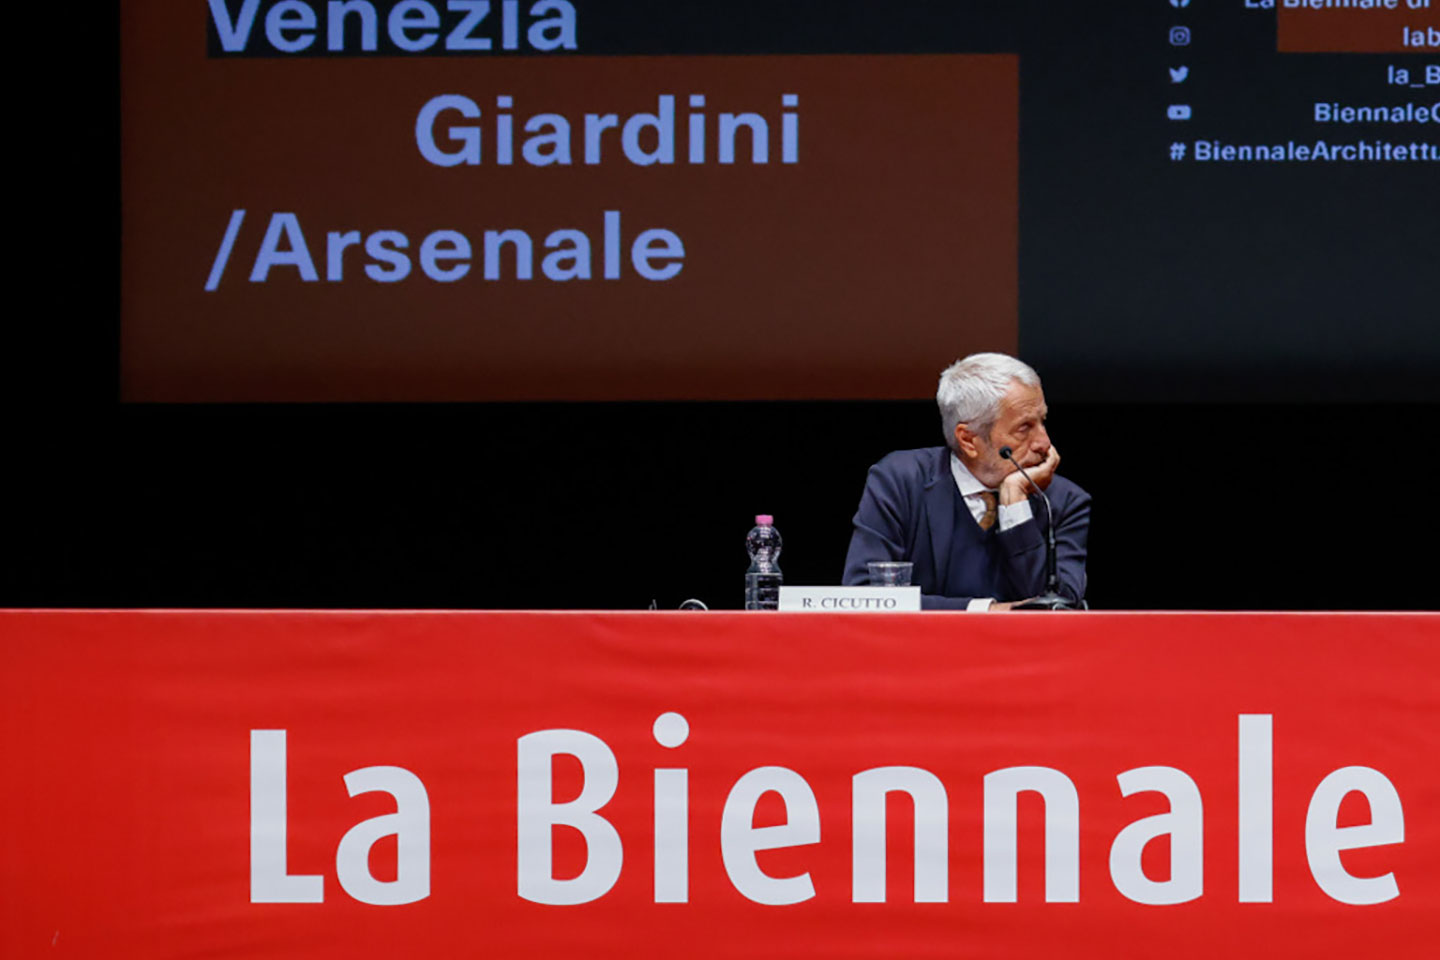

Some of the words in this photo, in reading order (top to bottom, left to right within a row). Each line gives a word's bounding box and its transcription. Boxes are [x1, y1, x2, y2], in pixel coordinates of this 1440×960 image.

[416, 94, 798, 167] Giardini
[205, 210, 685, 291] /Arsenale
[802, 597, 817, 609] R.
[821, 597, 897, 609] CICUTTO
[251, 730, 430, 905] La
[518, 712, 1404, 905] Biennale
